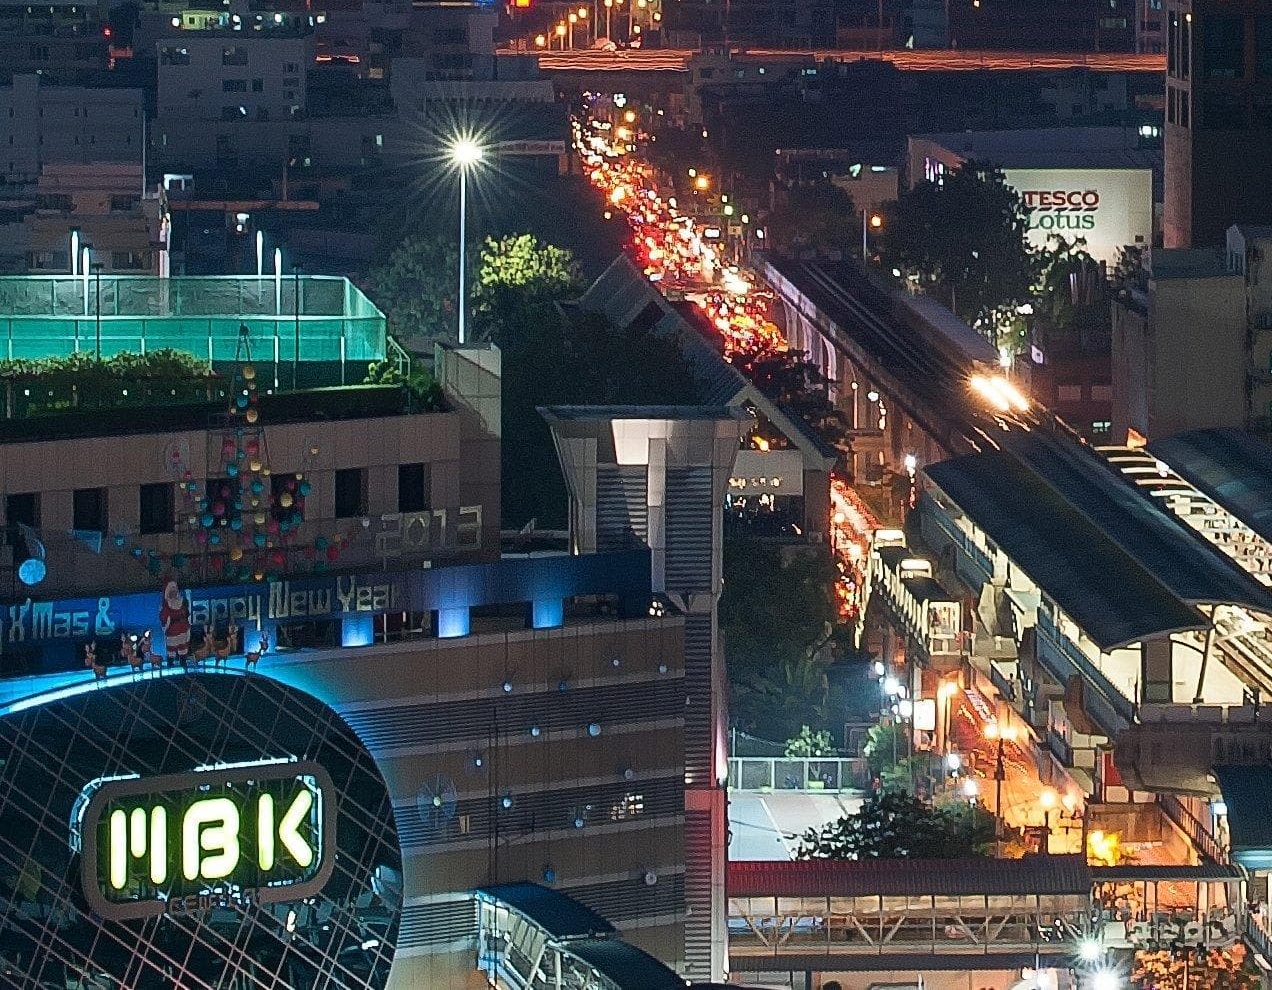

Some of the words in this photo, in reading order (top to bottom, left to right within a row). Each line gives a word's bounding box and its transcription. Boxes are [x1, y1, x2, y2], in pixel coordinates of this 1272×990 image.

[1022, 190, 1100, 207] TESCO
[1025, 210, 1096, 230] Lotus
[95, 597, 116, 636] &
[268, 580, 332, 619] New
[110, 789, 314, 890] MBK
